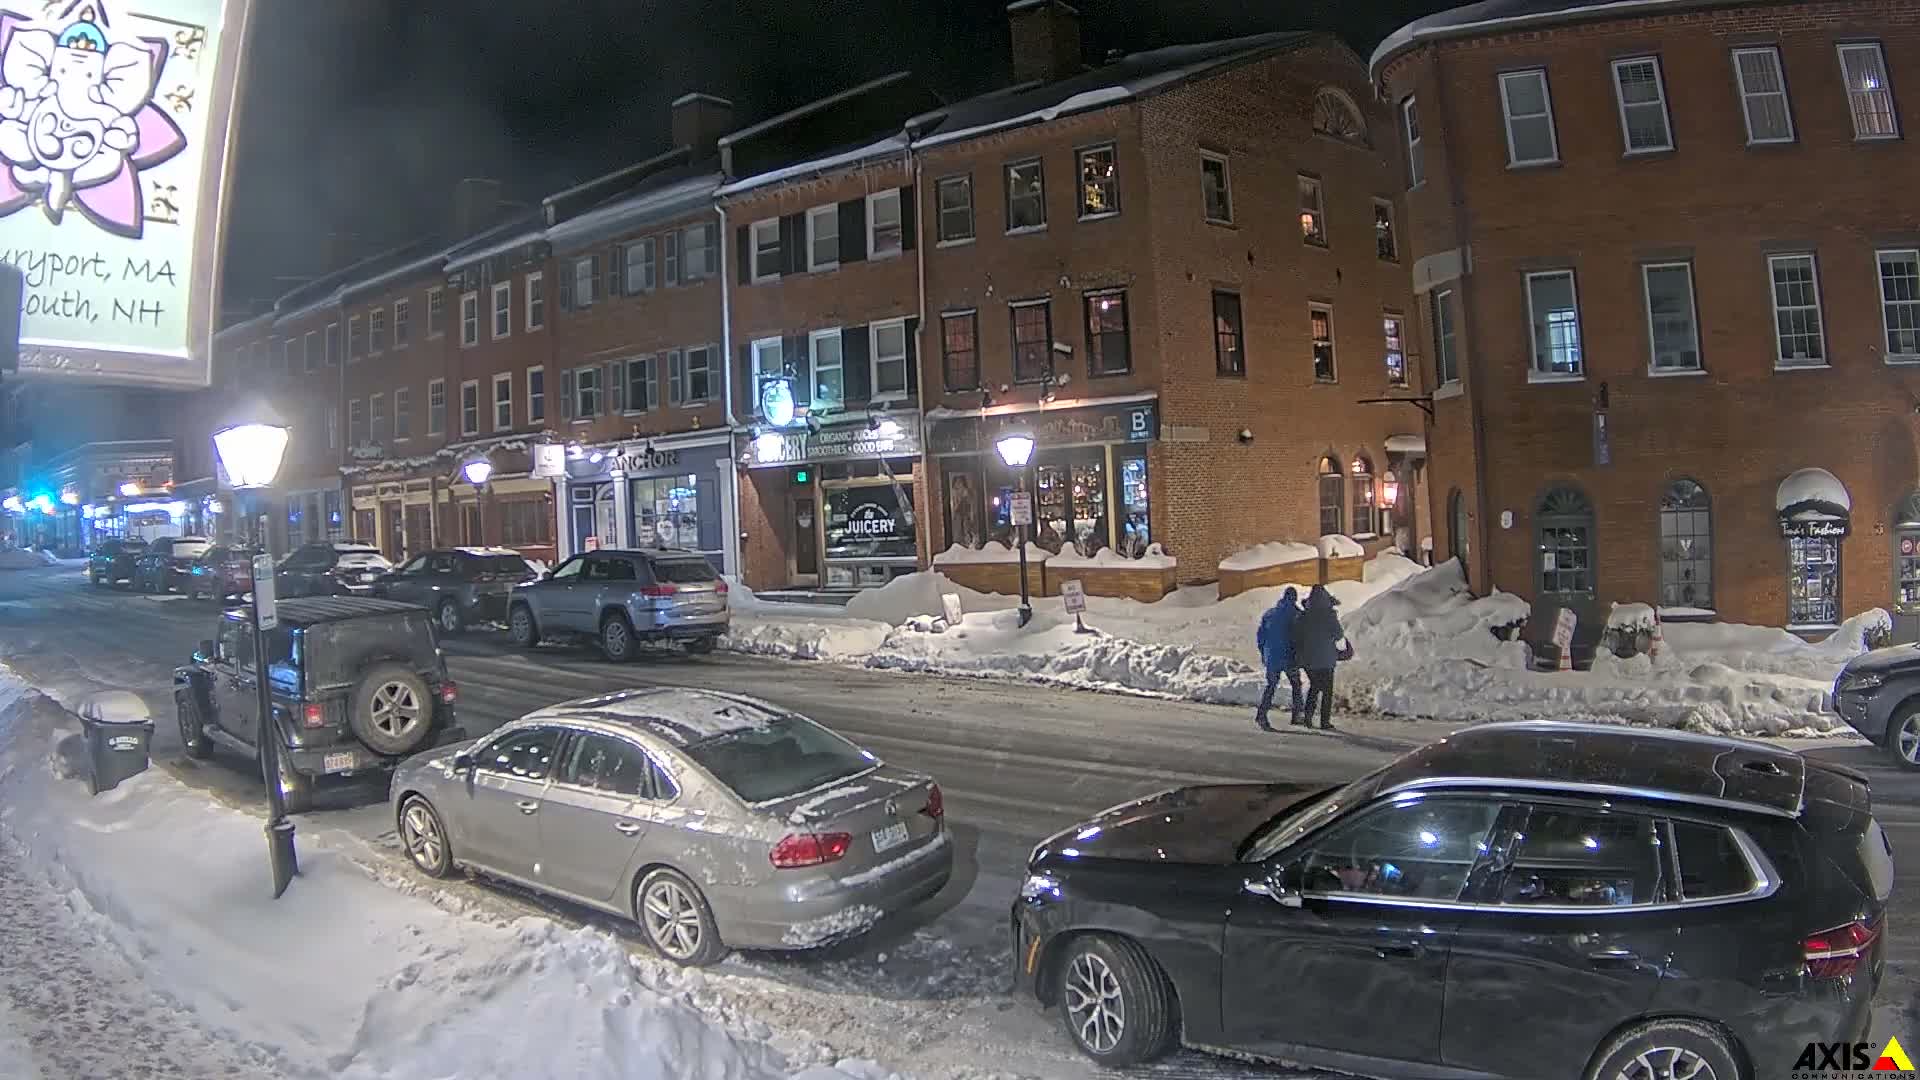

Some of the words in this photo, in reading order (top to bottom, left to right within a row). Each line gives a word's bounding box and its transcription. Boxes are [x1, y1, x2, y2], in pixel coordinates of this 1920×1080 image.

[122, 256, 176, 288] MA
[112, 297, 166, 328] NH
[612, 448, 680, 471] ANCHOR
[844, 518, 896, 534] JUICERY
